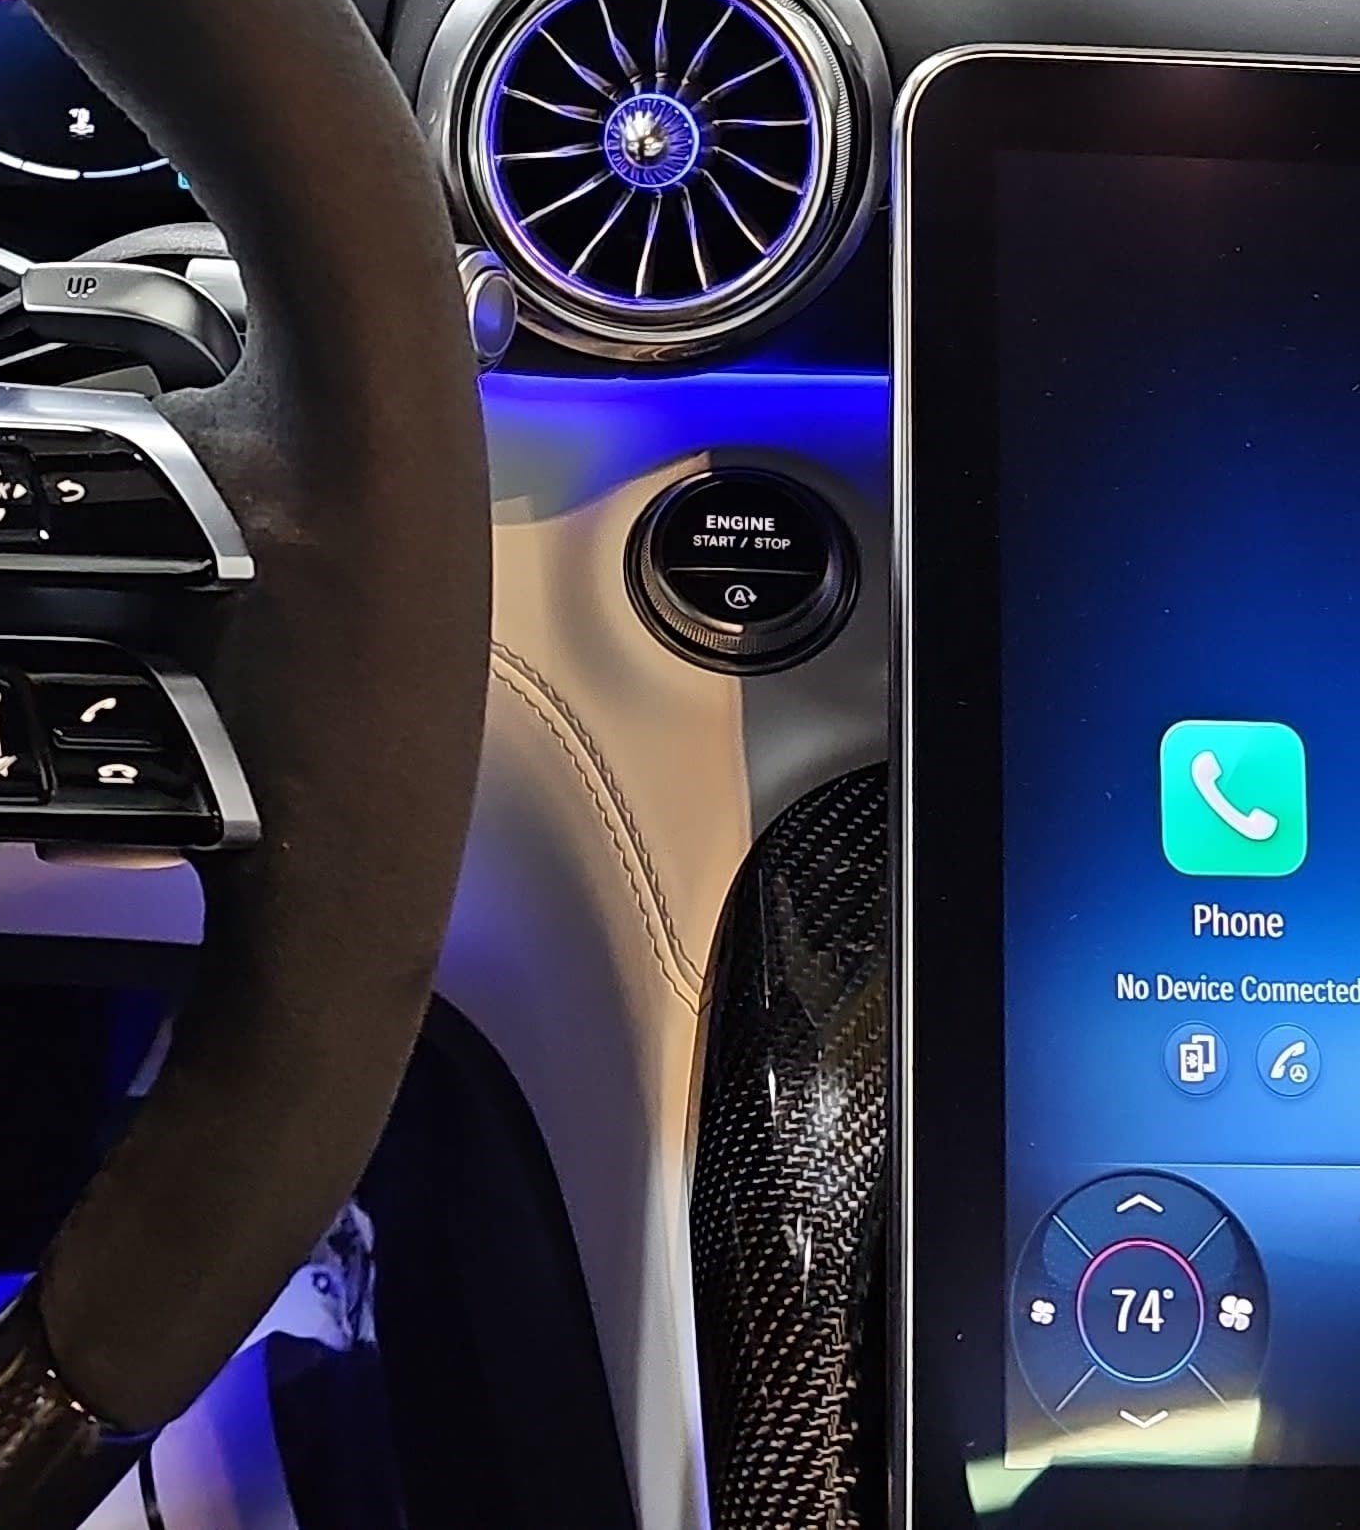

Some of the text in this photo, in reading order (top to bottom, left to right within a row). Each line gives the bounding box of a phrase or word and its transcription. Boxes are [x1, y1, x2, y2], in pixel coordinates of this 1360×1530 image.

[66, 277, 99, 299] UP
[705, 514, 776, 532] ENGINE
[693, 535, 736, 548] START
[754, 537, 791, 550] STOP
[1192, 903, 1284, 938] Phone
[1116, 973, 1149, 1001] No
[1156, 974, 1234, 1002] Device
[1110, 1287, 1175, 1334] 74°
